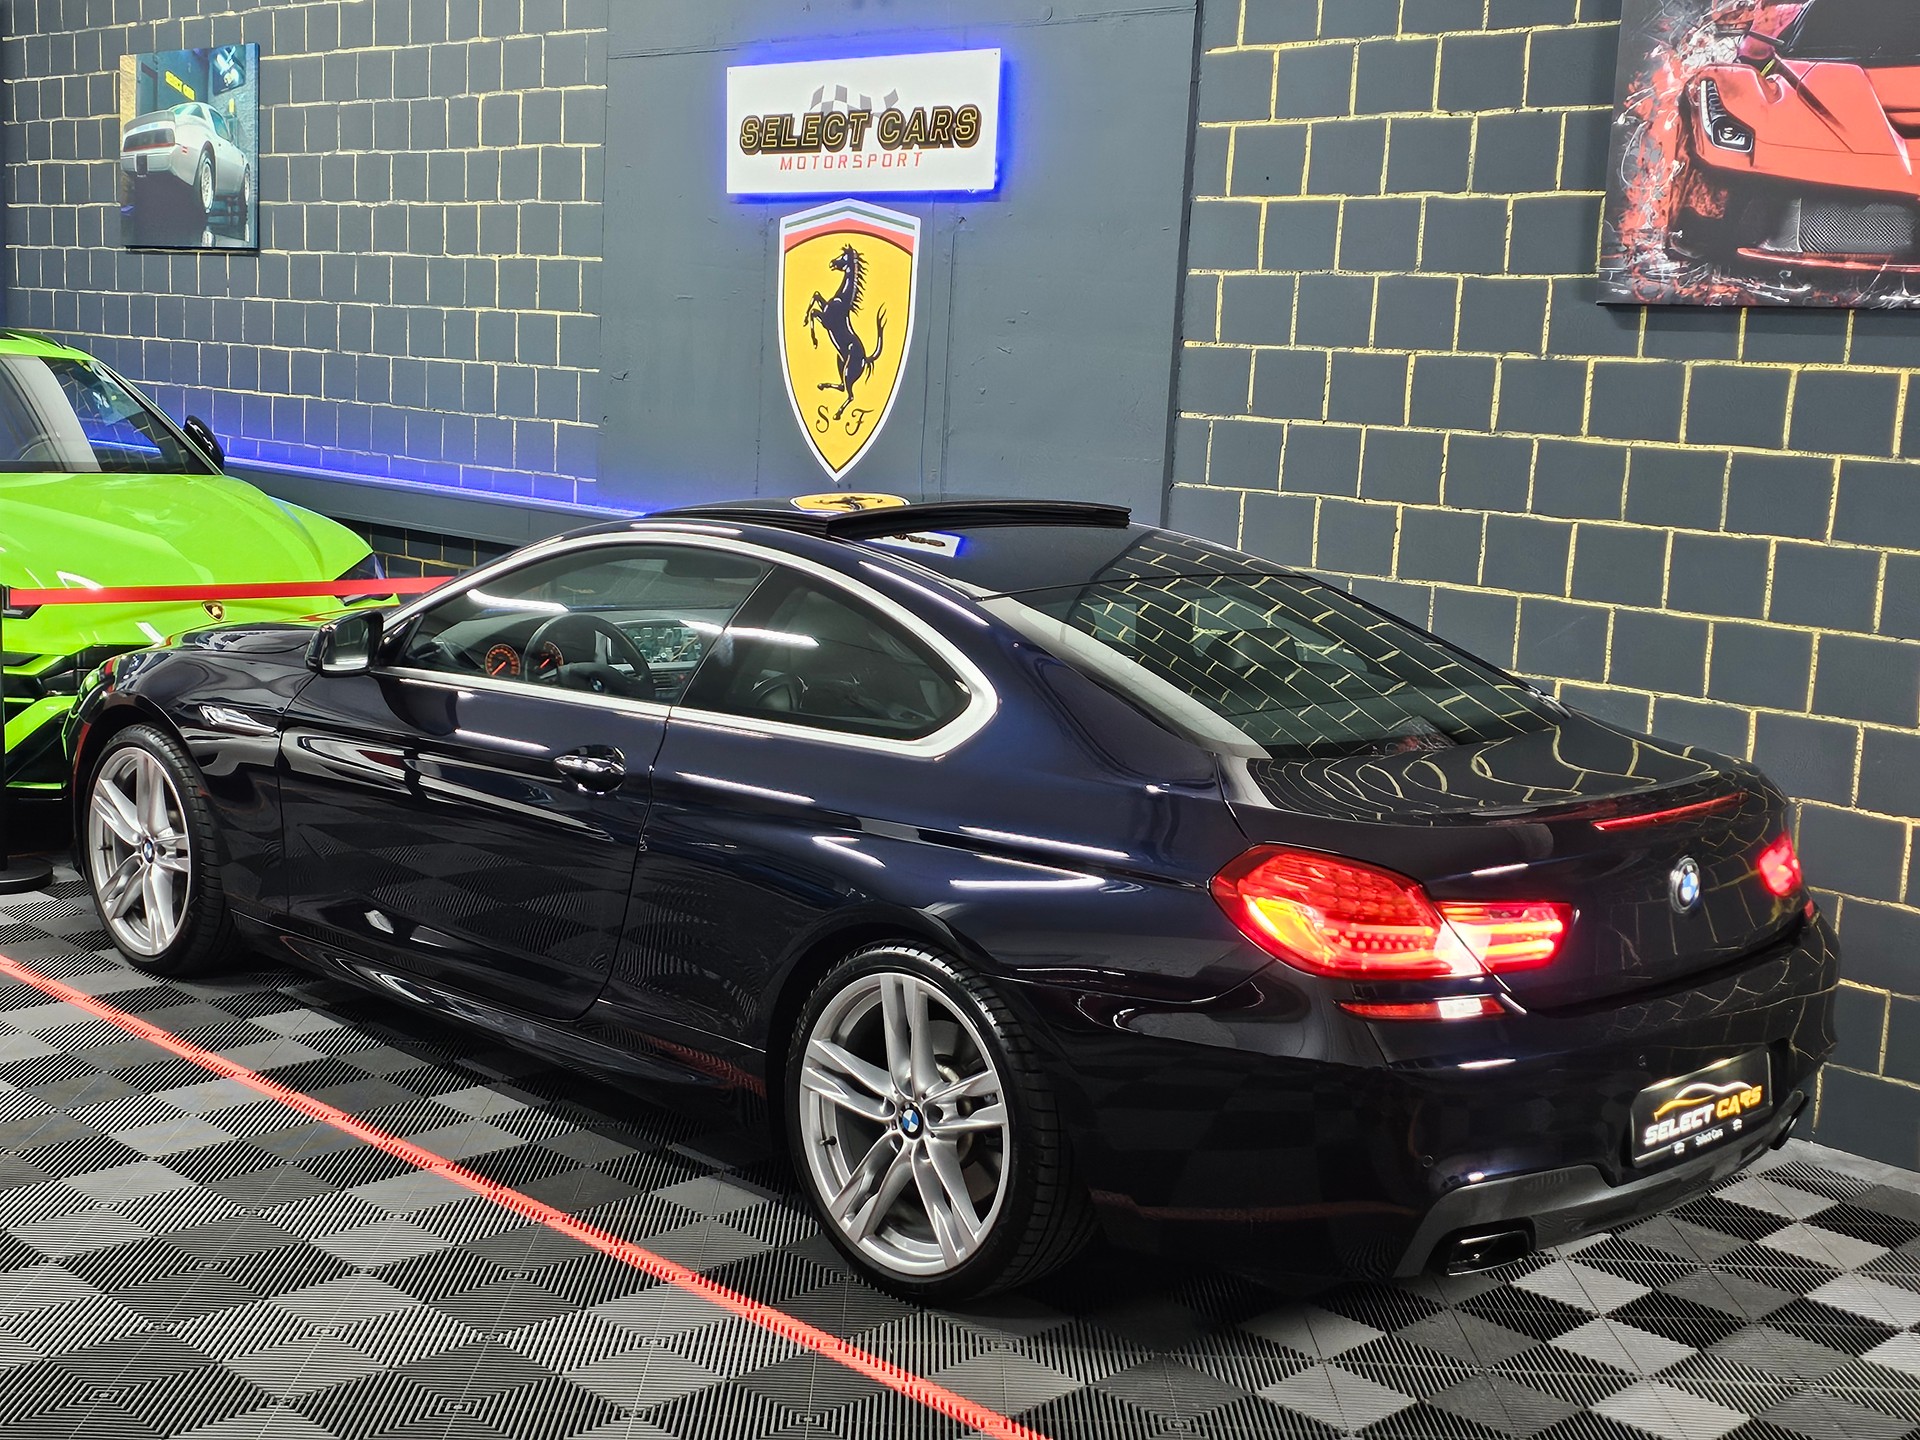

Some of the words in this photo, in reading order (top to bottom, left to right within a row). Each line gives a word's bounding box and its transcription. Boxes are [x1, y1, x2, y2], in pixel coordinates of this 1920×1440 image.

[739, 110, 873, 155] SELECT
[877, 103, 983, 151] CARS
[779, 151, 923, 171] MOTORSPORT
[815, 404, 830, 434] S
[844, 407, 875, 437] F
[1643, 1103, 1715, 1147] SELECT
[1716, 1085, 1763, 1119] CARS
